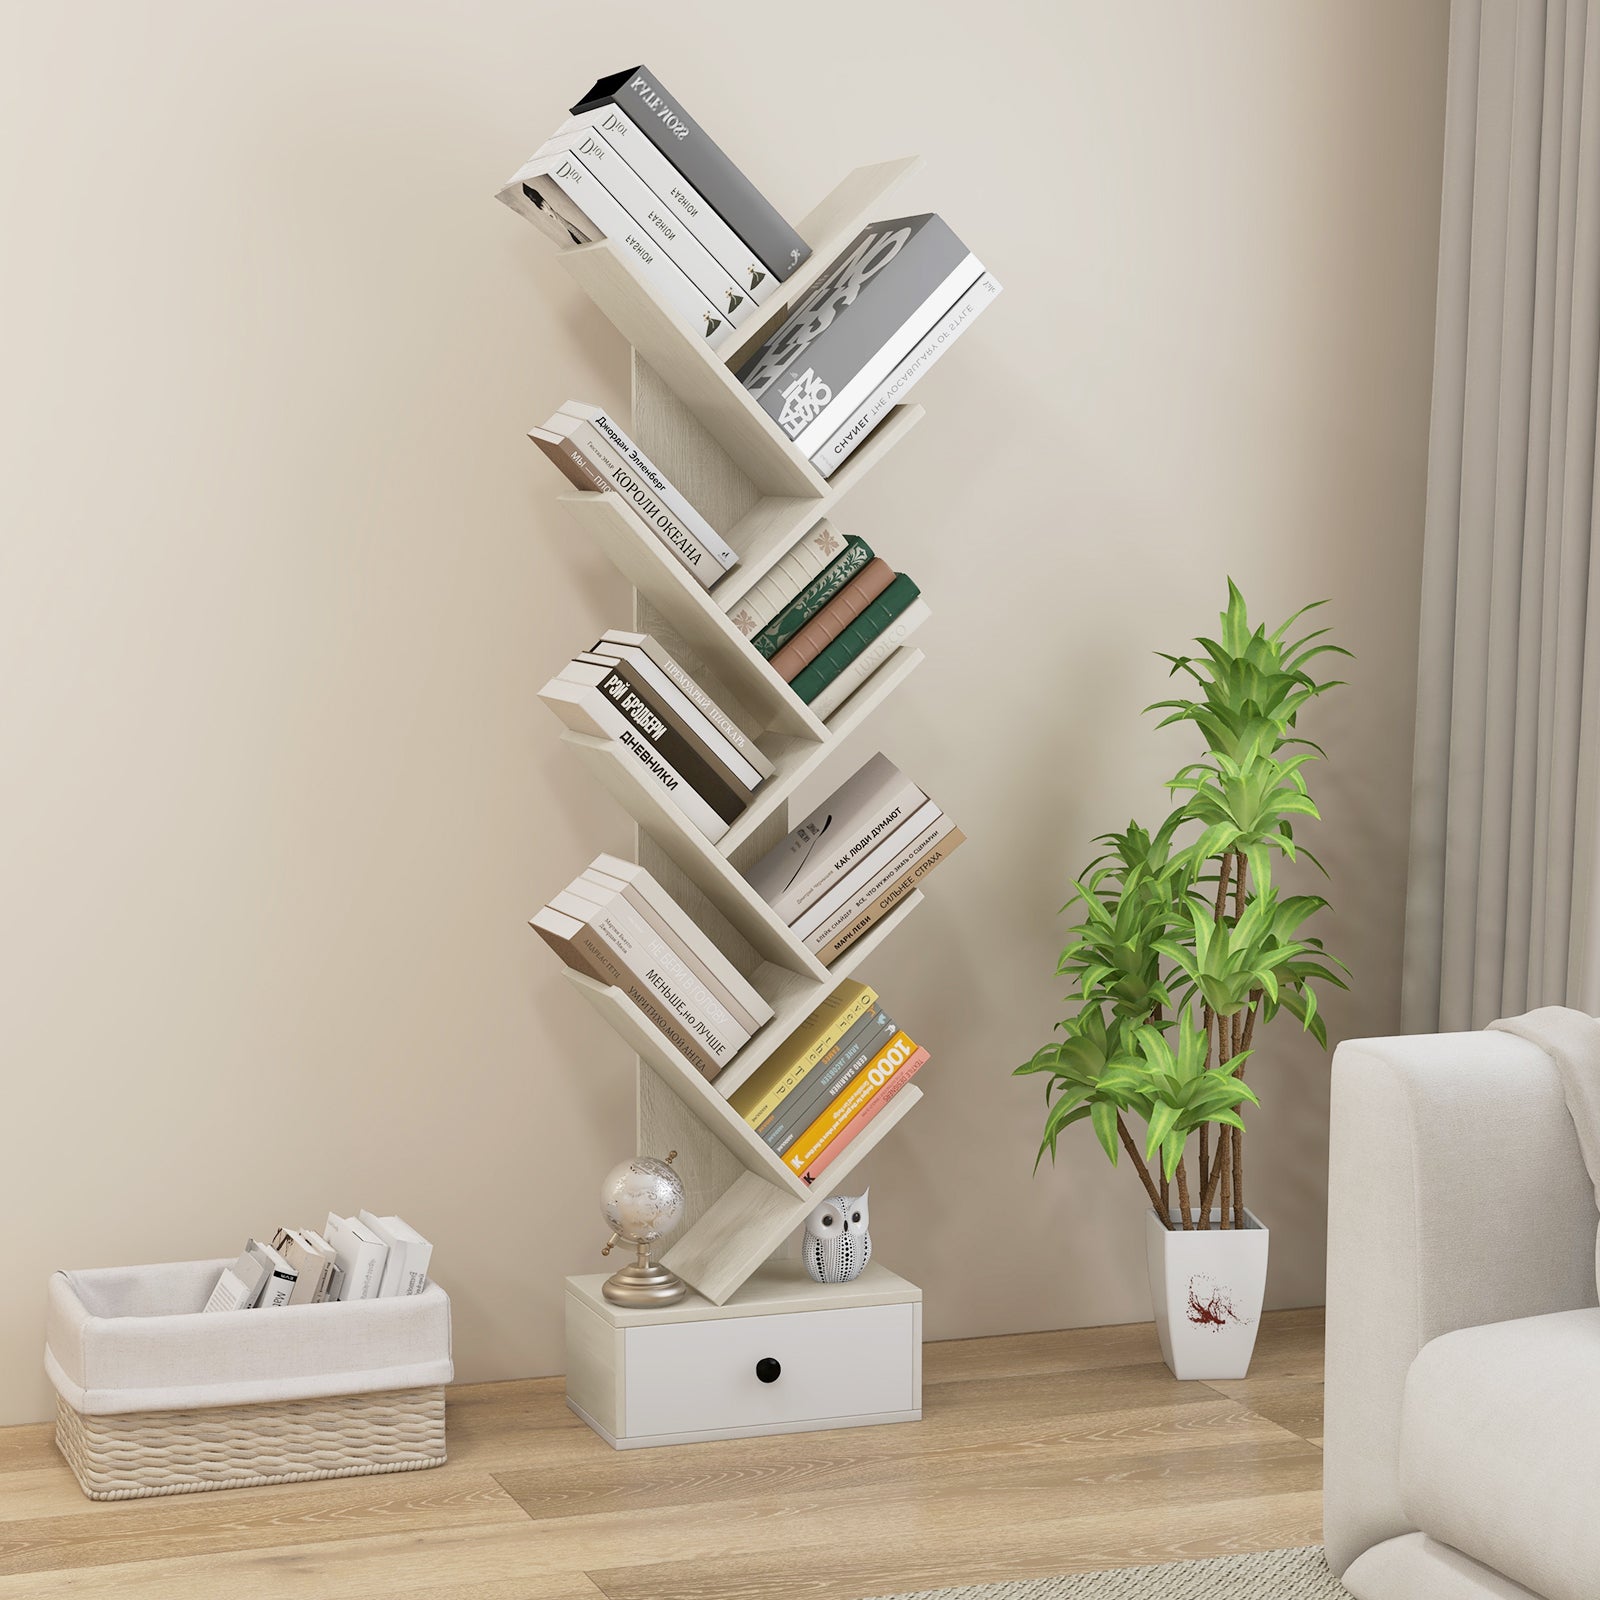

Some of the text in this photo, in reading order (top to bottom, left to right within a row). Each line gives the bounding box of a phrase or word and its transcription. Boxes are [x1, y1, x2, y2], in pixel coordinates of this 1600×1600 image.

[595, 416, 666, 491] Джордан Элленберг
[612, 468, 702, 566] КОРОЛИ ОКЕАНА
[604, 675, 668, 741] РЭЙ БРЭДБЕРИ
[663, 660, 746, 749] ПРЕМУДРЫЙ ПИСКАРЬ
[619, 731, 679, 791] ДНЕВНИКИ
[834, 807, 902, 870] КАК ЛЮДИ ДУМАЮТ
[831, 909, 853, 929] СНАЙДЕР
[866, 887, 877, 898] ЧТО
[876, 871, 895, 888] НУЖНО
[894, 858, 910, 873] ЗНАТЬ
[913, 831, 939, 855] СЦЕНАРИИ
[833, 852, 943, 950] МАРК ЛЕВИ СИЛЬНЕЕ СТРАХА
[659, 952, 687, 981] БЕРИ
[689, 986, 727, 1024] ГОЛОВУ
[682, 1045, 707, 1071] АНГЕЛ
[692, 1021, 725, 1055] ЛУЧШЕ
[843, 1043, 859, 1059] ARNE
[852, 1055, 866, 1069] EERO
[868, 1038, 910, 1086] 1000
[819, 1058, 846, 1085] JACOBSEN
[828, 1068, 854, 1094] SAARINEN
[882, 1076, 907, 1101] DESIGNERS
[905, 1059, 923, 1077] TEXTILE
[804, 1172, 815, 1184] K
